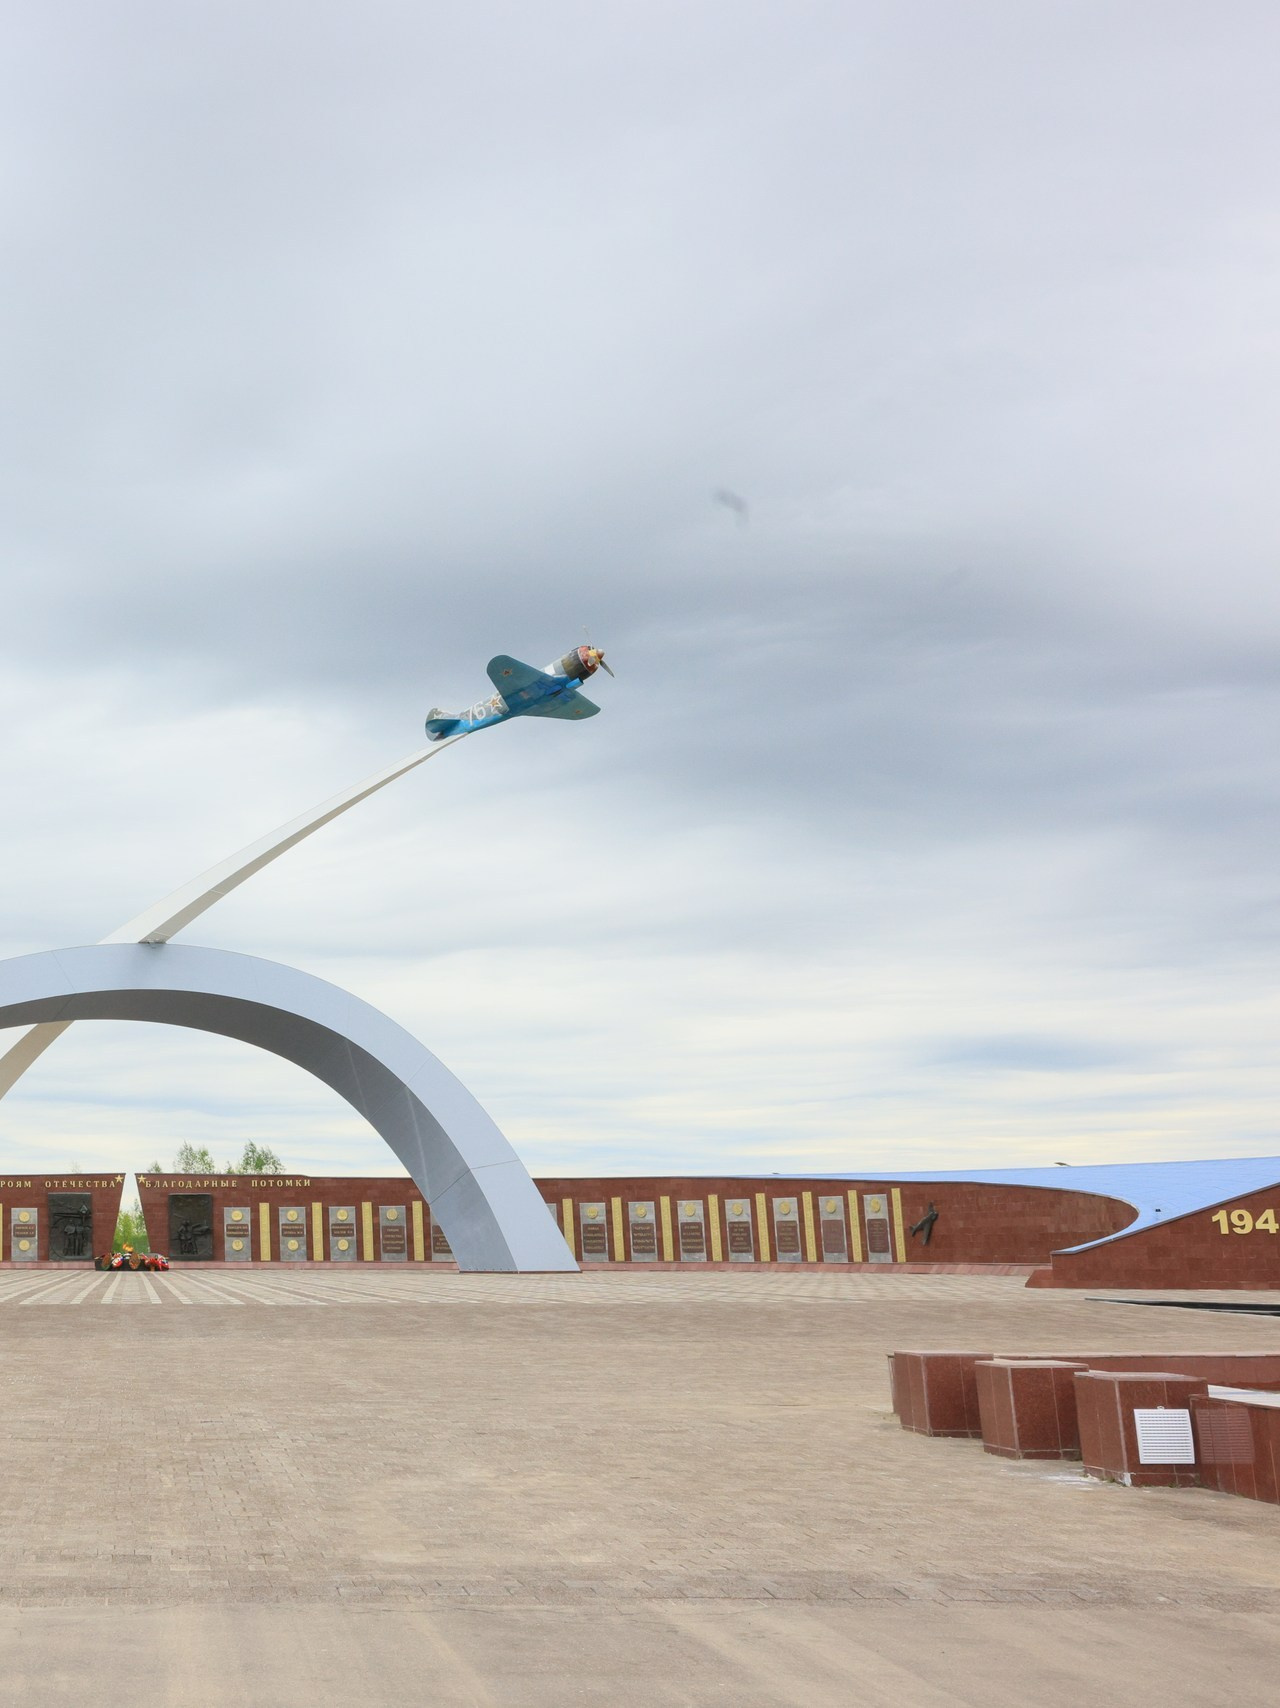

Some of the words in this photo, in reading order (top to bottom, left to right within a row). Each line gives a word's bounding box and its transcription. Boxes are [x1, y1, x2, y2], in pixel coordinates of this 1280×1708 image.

[44, 1180, 116, 1188] ОТЕЧЕСТВА
[144, 1179, 238, 1188] БЛАГОДАРНЫЕ
[251, 1179, 311, 1187] ПОТОМКИ
